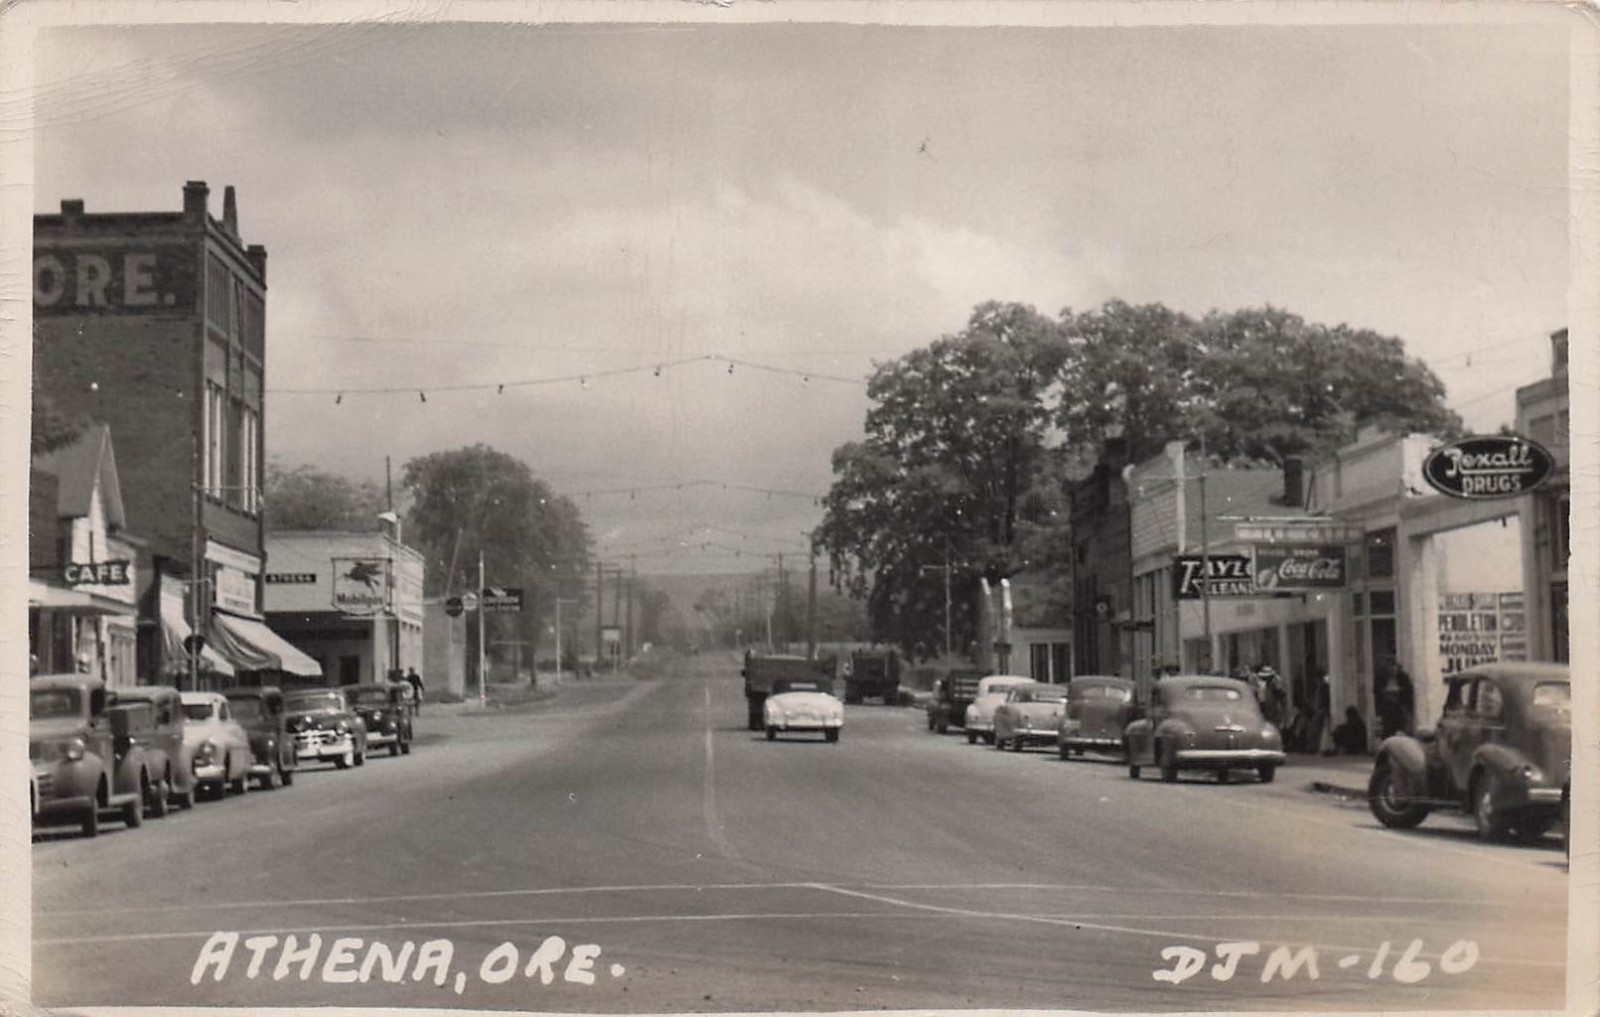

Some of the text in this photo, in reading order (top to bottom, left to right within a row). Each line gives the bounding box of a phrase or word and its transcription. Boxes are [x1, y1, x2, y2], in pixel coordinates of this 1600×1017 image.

[1443, 445, 1533, 477] Rexall
[1462, 475, 1521, 493] DRUGS
[64, 565, 123, 582] CAFE
[1439, 643, 1495, 656] MONDAY
